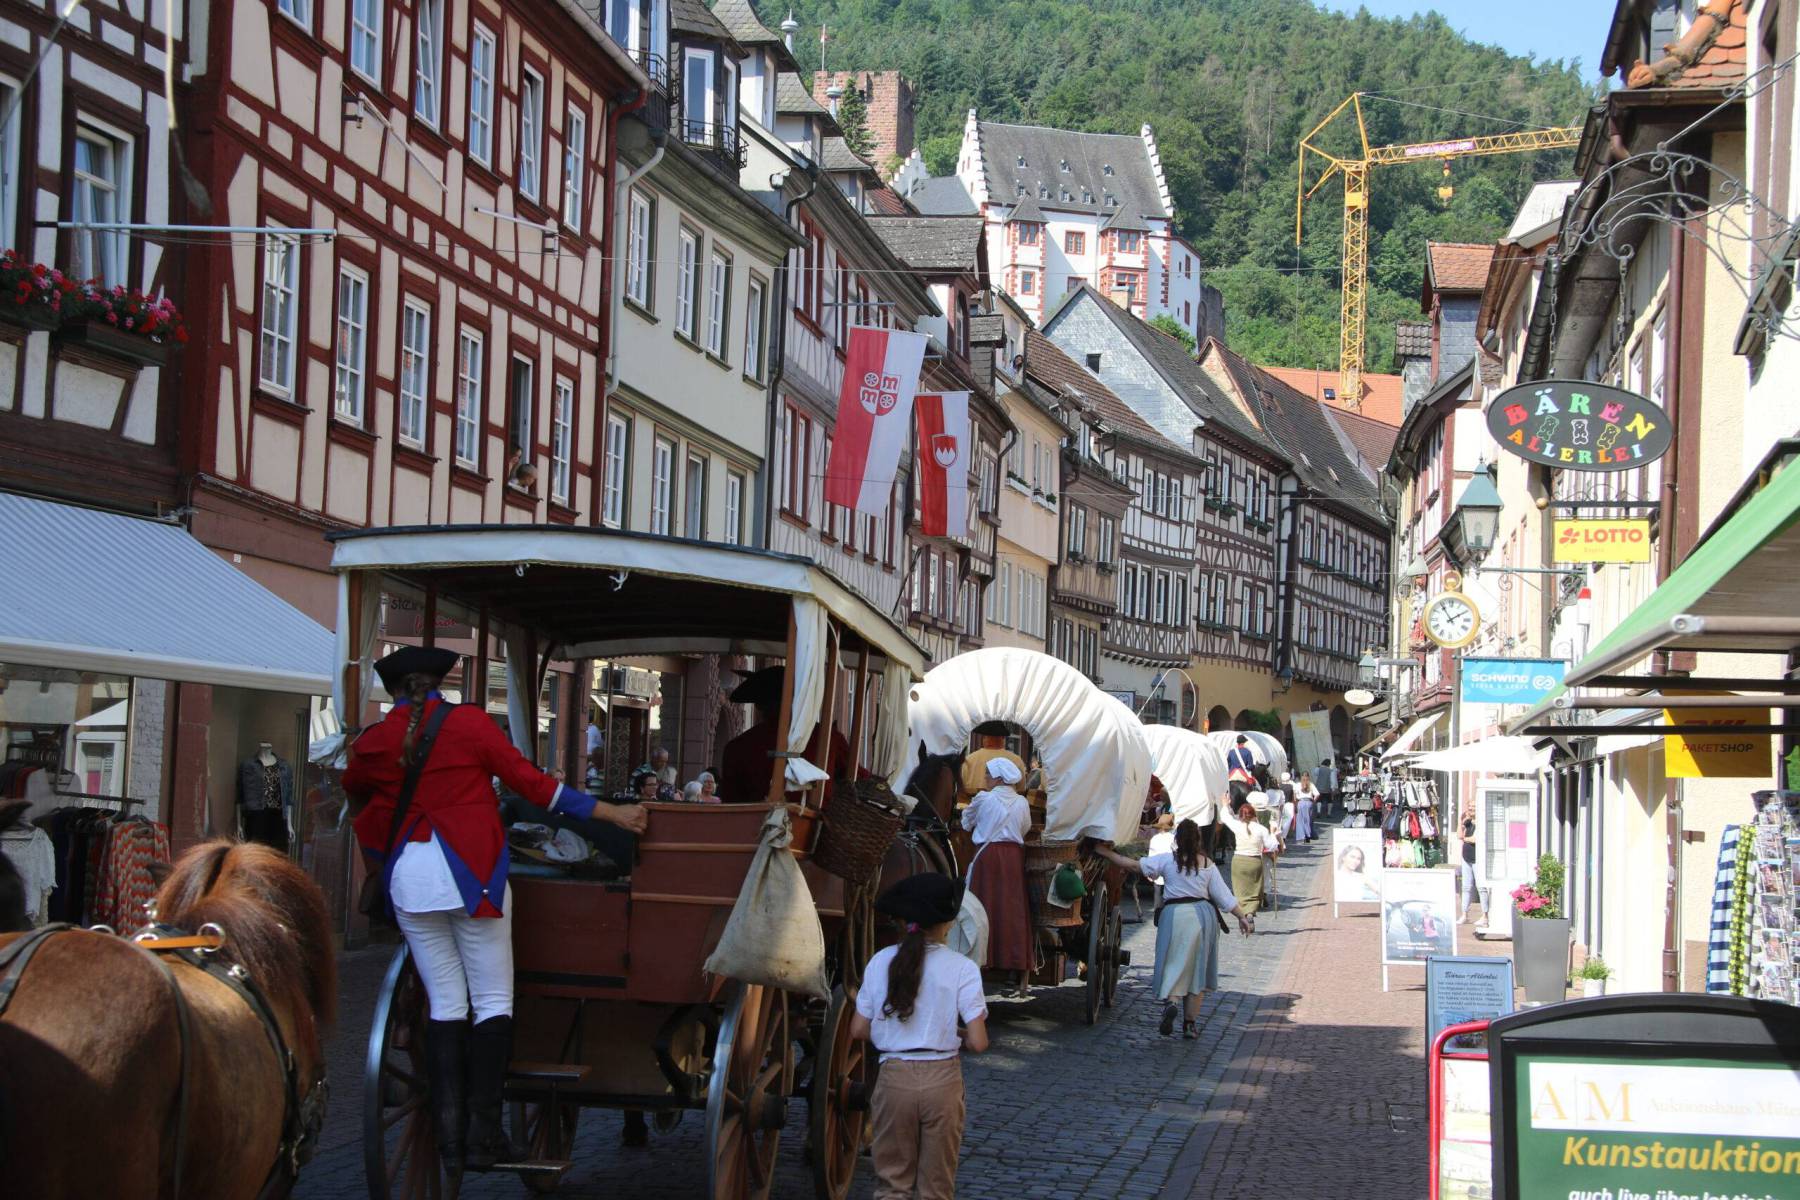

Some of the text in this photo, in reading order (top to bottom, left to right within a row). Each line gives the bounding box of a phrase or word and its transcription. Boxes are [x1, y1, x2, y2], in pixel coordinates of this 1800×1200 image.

[1503, 388, 1657, 441] BÄREN
[1506, 429, 1644, 465] ALLERLEI
[1584, 529, 1643, 543] LOTTO
[1682, 743, 1754, 753] PAKETSHOP
